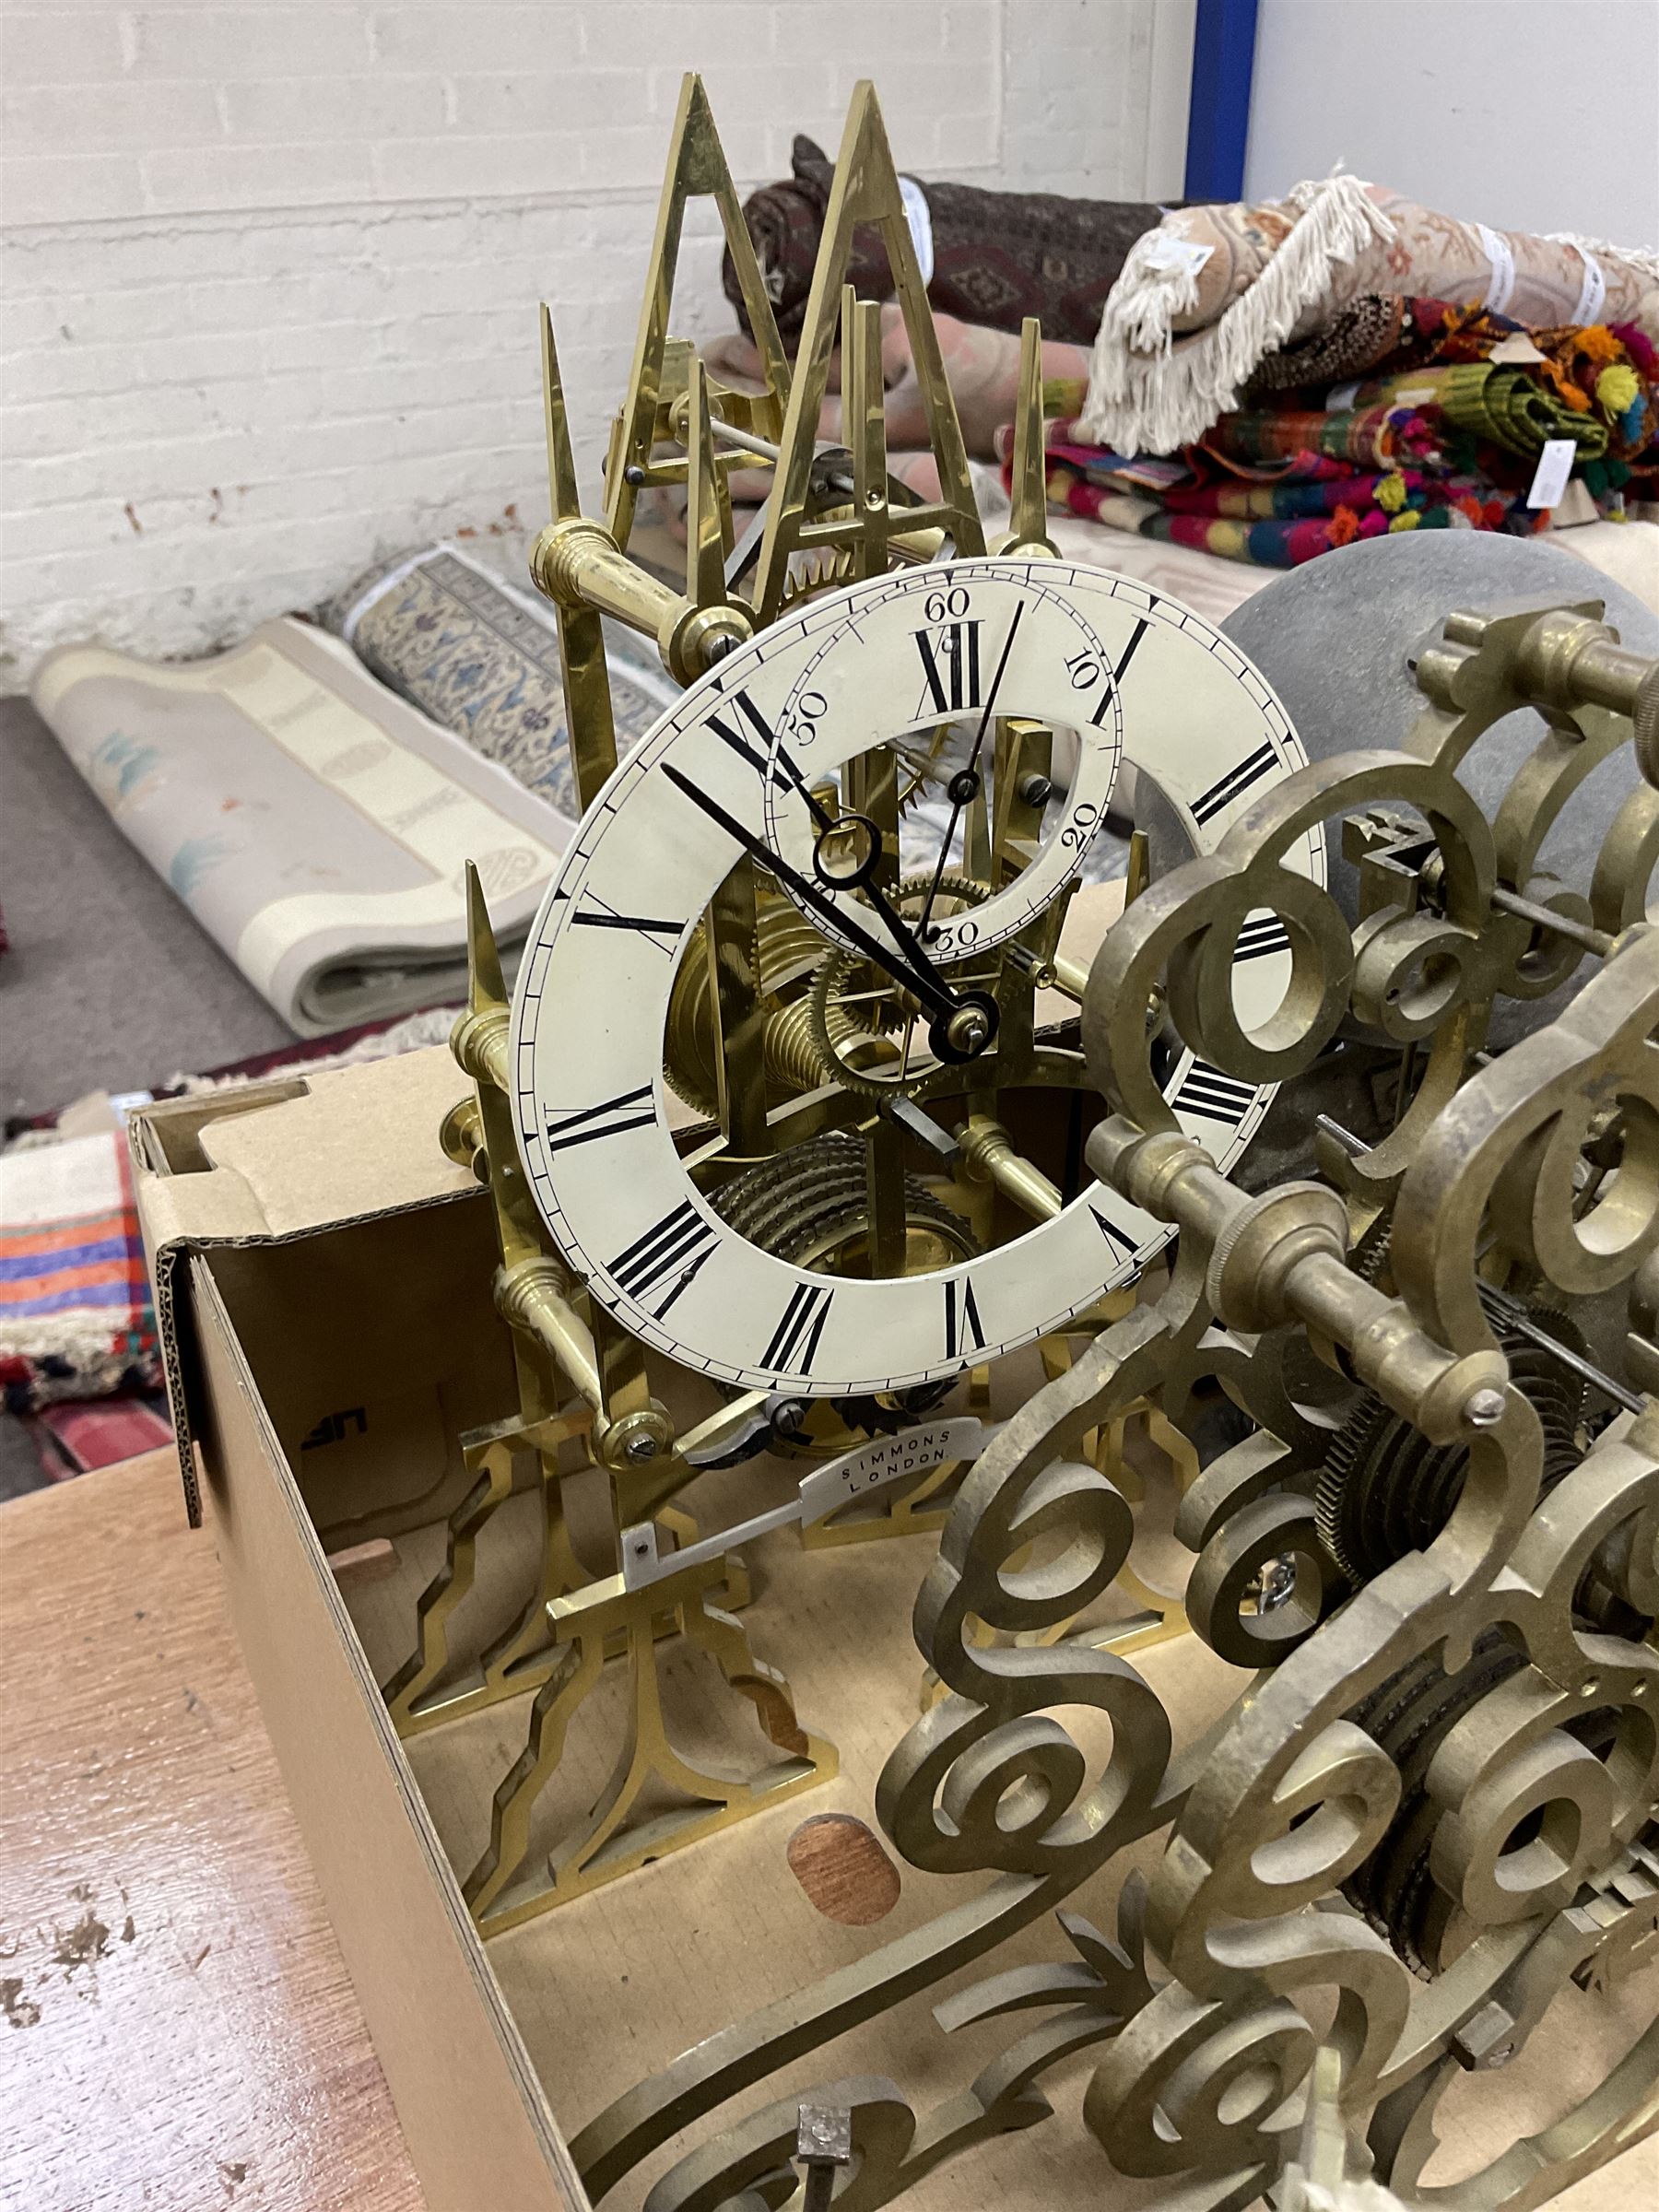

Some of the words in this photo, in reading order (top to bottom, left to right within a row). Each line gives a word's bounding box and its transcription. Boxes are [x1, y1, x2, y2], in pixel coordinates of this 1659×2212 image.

[924, 587, 971, 623] 60
[907, 618, 986, 724] XII
[1064, 646, 1100, 689] 10
[699, 685, 811, 800] XI
[787, 691, 828, 747] 50
[1188, 732, 1283, 830] II
[1062, 802, 1099, 853] 20
[567, 881, 689, 962] X
[935, 922, 979, 952] 30
[544, 1077, 659, 1162] IX
[600, 1194, 724, 1326] VIII
[1088, 1203, 1146, 1271] V
[752, 1280, 835, 1377] VII
[937, 1276, 993, 1363] VI
[841, 1430, 950, 1480] SIMMONS
